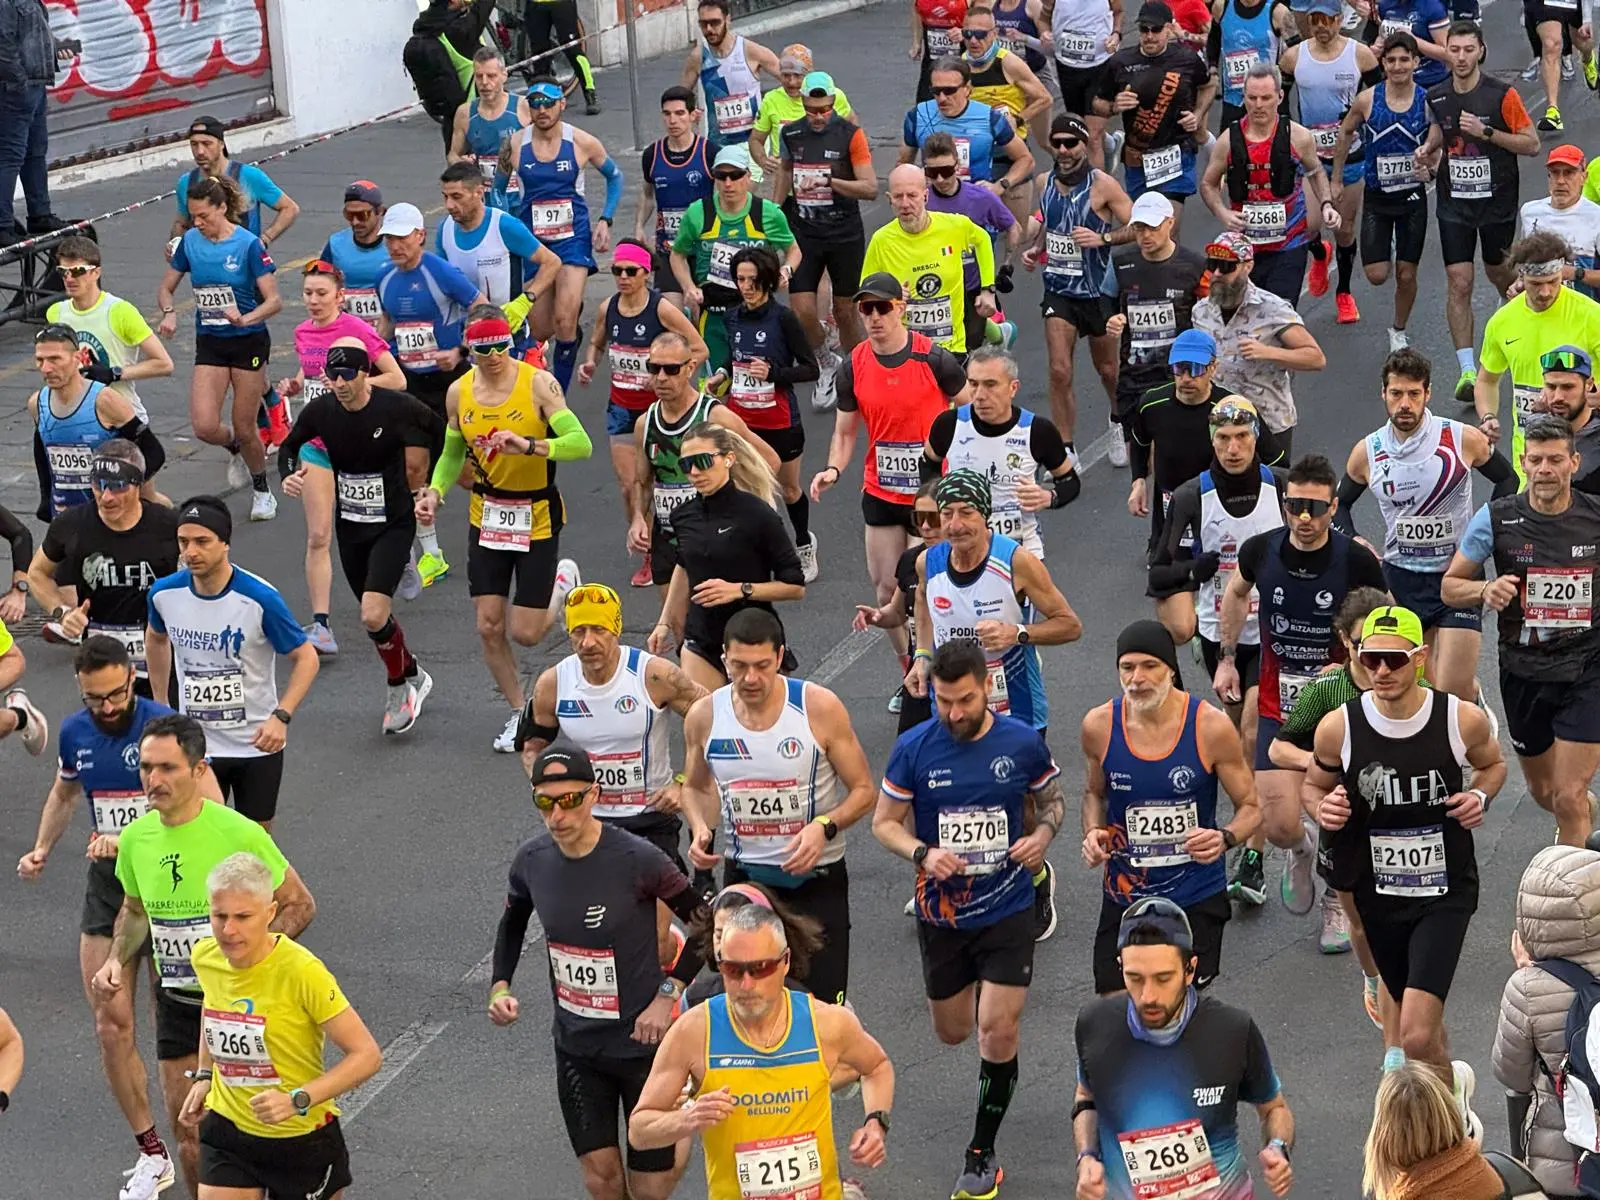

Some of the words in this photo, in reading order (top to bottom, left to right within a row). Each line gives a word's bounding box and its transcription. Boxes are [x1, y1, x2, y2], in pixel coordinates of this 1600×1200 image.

[1066, 40, 1089, 50] 2187
[1234, 60, 1250, 72] 851
[725, 104, 742, 116] 119
[1151, 152, 1176, 169] 2361
[1384, 162, 1412, 175] 3778
[1456, 164, 1483, 178] 2550
[546, 210, 560, 222] 97
[1250, 211, 1279, 224] 2568
[1051, 239, 1075, 255] 2328
[912, 263, 940, 272] BRESCIA
[202, 288, 229, 306] 2281
[356, 300, 378, 313] 814
[914, 309, 944, 325] 2719
[1136, 310, 1167, 326] 2416
[405, 333, 425, 347] 130
[620, 358, 641, 371] 659
[58, 455, 87, 470] 2096
[885, 456, 917, 471] 2103
[344, 484, 376, 501] 2236
[499, 511, 516, 526] 90
[1405, 523, 1445, 539] 2092
[1543, 583, 1576, 600] 220
[193, 685, 233, 702] 2425
[595, 768, 628, 786] 208
[748, 797, 784, 816] 264
[109, 807, 139, 827] 128
[951, 821, 996, 843] 2570
[1139, 815, 1186, 836] 2483
[1384, 846, 1432, 867] 2107
[565, 963, 597, 986] 149
[219, 1031, 251, 1056] 266
[1193, 1086, 1226, 1100] SWATT
[1197, 1095, 1222, 1107] CLUB
[746, 1105, 791, 1117] BELLUNO
[1143, 1142, 1190, 1172] 268
[757, 1155, 801, 1186] 215
